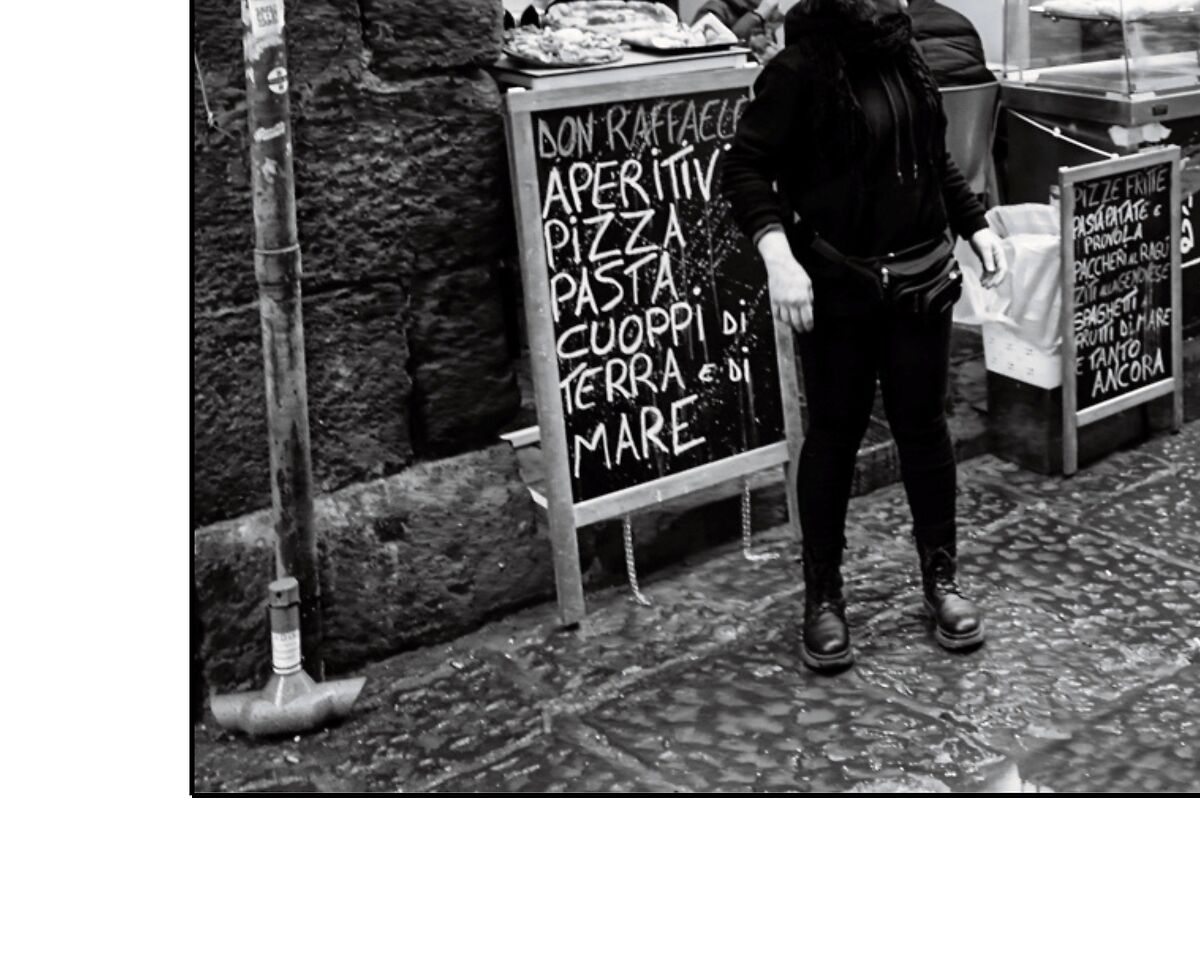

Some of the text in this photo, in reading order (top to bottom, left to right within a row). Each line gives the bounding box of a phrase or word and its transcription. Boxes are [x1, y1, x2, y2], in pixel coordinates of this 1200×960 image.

[538, 111, 593, 158] DON
[542, 140, 732, 219] APERITIV
[1074, 178, 1122, 208] PIZZE
[544, 203, 686, 270] PIZZA
[1084, 222, 1143, 254] PROVOLA
[549, 251, 679, 322] PASTA
[1074, 285, 1138, 332] SPAGHETTI
[556, 286, 747, 359] CUOPPI DI
[1075, 318, 1115, 349] FRUTTI
[1136, 307, 1172, 333] MARE
[560, 348, 686, 414] TERRA
[728, 345, 750, 383] DI
[1089, 339, 1141, 372] TANTO
[1091, 347, 1164, 398] ANCORA
[573, 394, 706, 478] MARE
